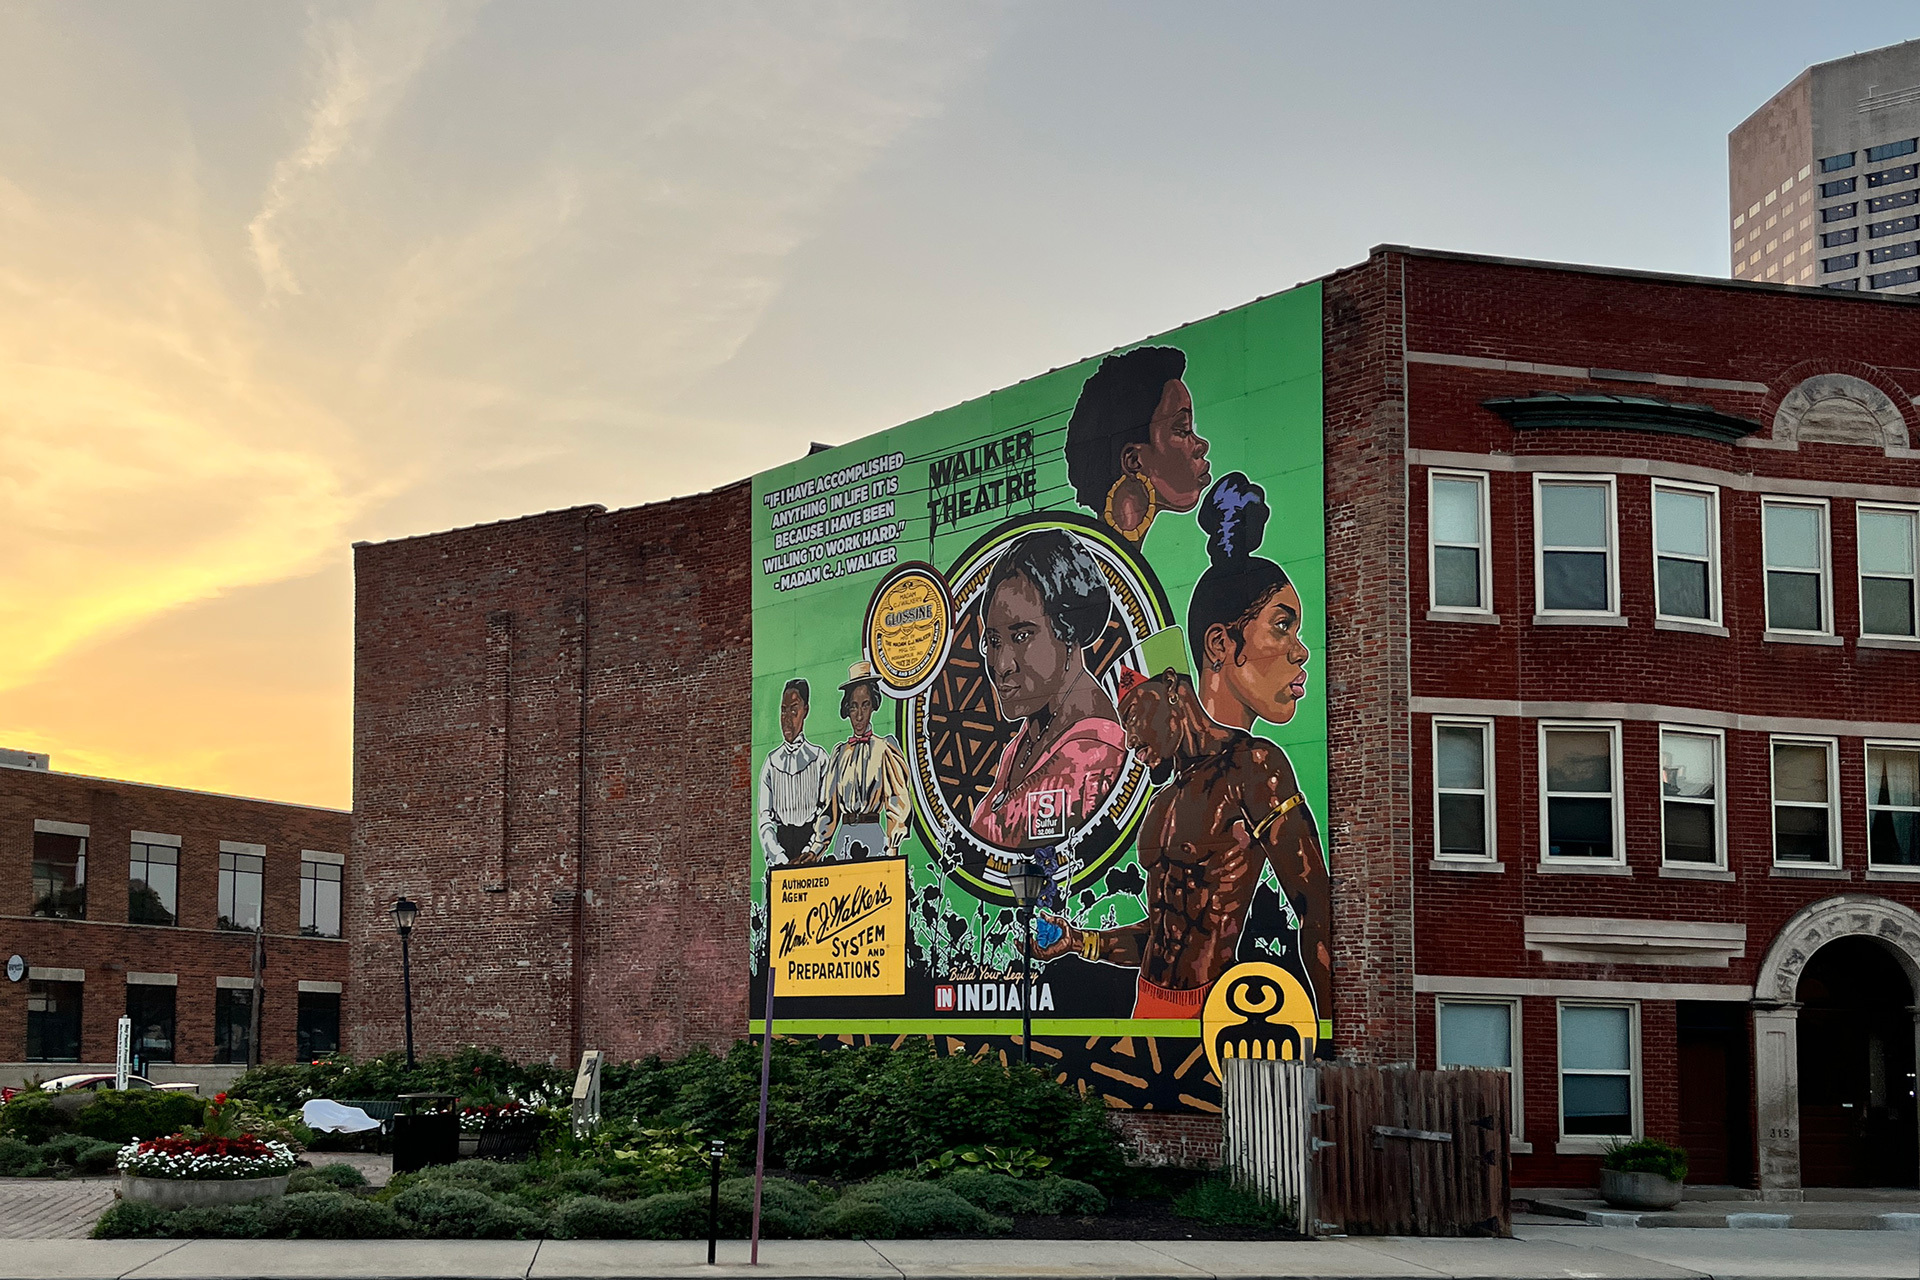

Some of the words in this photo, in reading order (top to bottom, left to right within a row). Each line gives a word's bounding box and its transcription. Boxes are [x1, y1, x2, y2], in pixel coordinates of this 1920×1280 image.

[930, 429, 1033, 489] WALKER
[786, 480, 815, 502] HAVE
[816, 452, 904, 493] ACCOMPLISHED
[772, 499, 827, 529] ANYTHING
[831, 494, 842, 511] IN
[844, 485, 869, 507] LIFE
[872, 480, 885, 498] IT
[886, 476, 898, 494] IS
[927, 468, 1036, 523] THEATRE
[775, 522, 824, 549] BECAUSE
[825, 520, 830, 535] I
[830, 511, 862, 533] HAVE
[862, 500, 895, 524] BEEN
[763, 548, 808, 574] WILLING
[809, 544, 824, 561] TO
[825, 533, 861, 557] WORK
[845, 546, 897, 574] WALKER
[885, 604, 933, 626] GLOSSINE
[1038, 794, 1055, 819] S
[1035, 818, 1058, 829] Sulfur
[782, 877, 829, 890] AUTHORIZED
[782, 892, 808, 903] AGENT
[831, 925, 885, 957] SYSTEM
[867, 948, 885, 957] AND
[788, 960, 880, 980] PREPARATIONS
[949, 967, 977, 981] Build
[979, 965, 1001, 981] Your
[937, 988, 952, 1008] IN
[1770, 1128, 1790, 1138] 315
